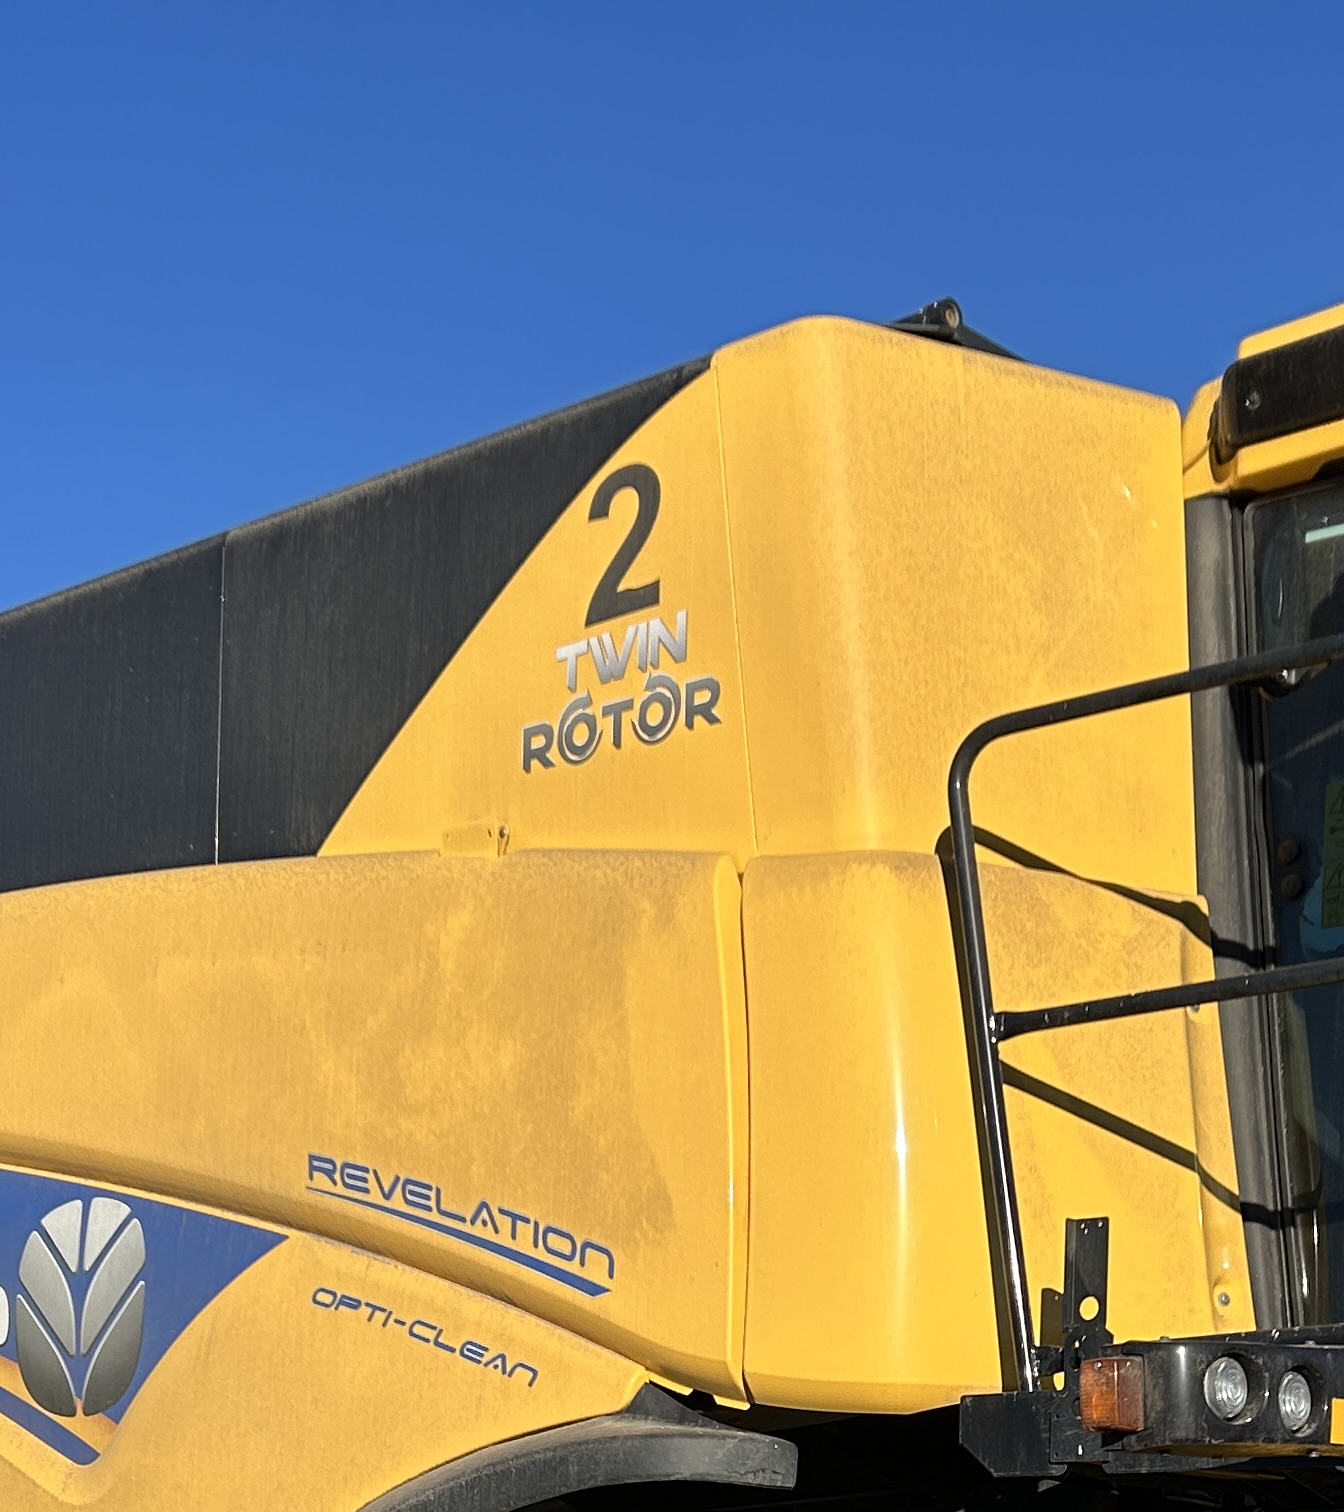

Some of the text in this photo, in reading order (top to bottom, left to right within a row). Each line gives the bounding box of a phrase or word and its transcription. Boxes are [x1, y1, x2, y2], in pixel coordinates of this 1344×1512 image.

[585, 462, 661, 628] 2
[556, 609, 688, 693] TWIN
[521, 671, 722, 775] ROTOR
[308, 1152, 615, 1281] REVELATION
[311, 1287, 539, 1387] OPTI-CLEAN
